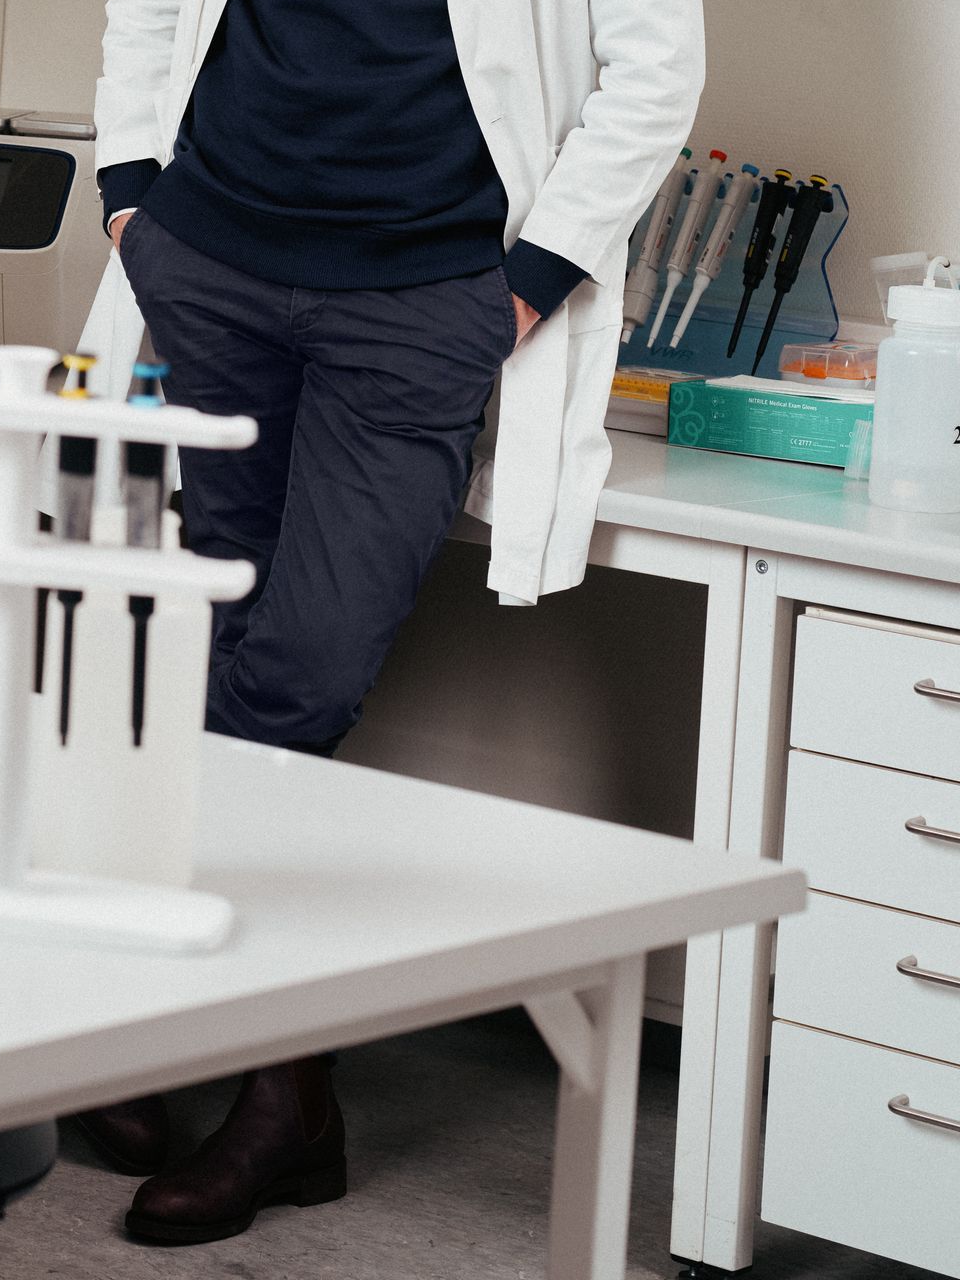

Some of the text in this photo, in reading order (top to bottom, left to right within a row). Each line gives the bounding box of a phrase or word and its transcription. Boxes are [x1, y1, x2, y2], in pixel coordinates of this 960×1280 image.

[748, 397, 768, 405] NITRILE
[769, 400, 788, 408] Medical
[802, 403, 818, 411] Gloves
